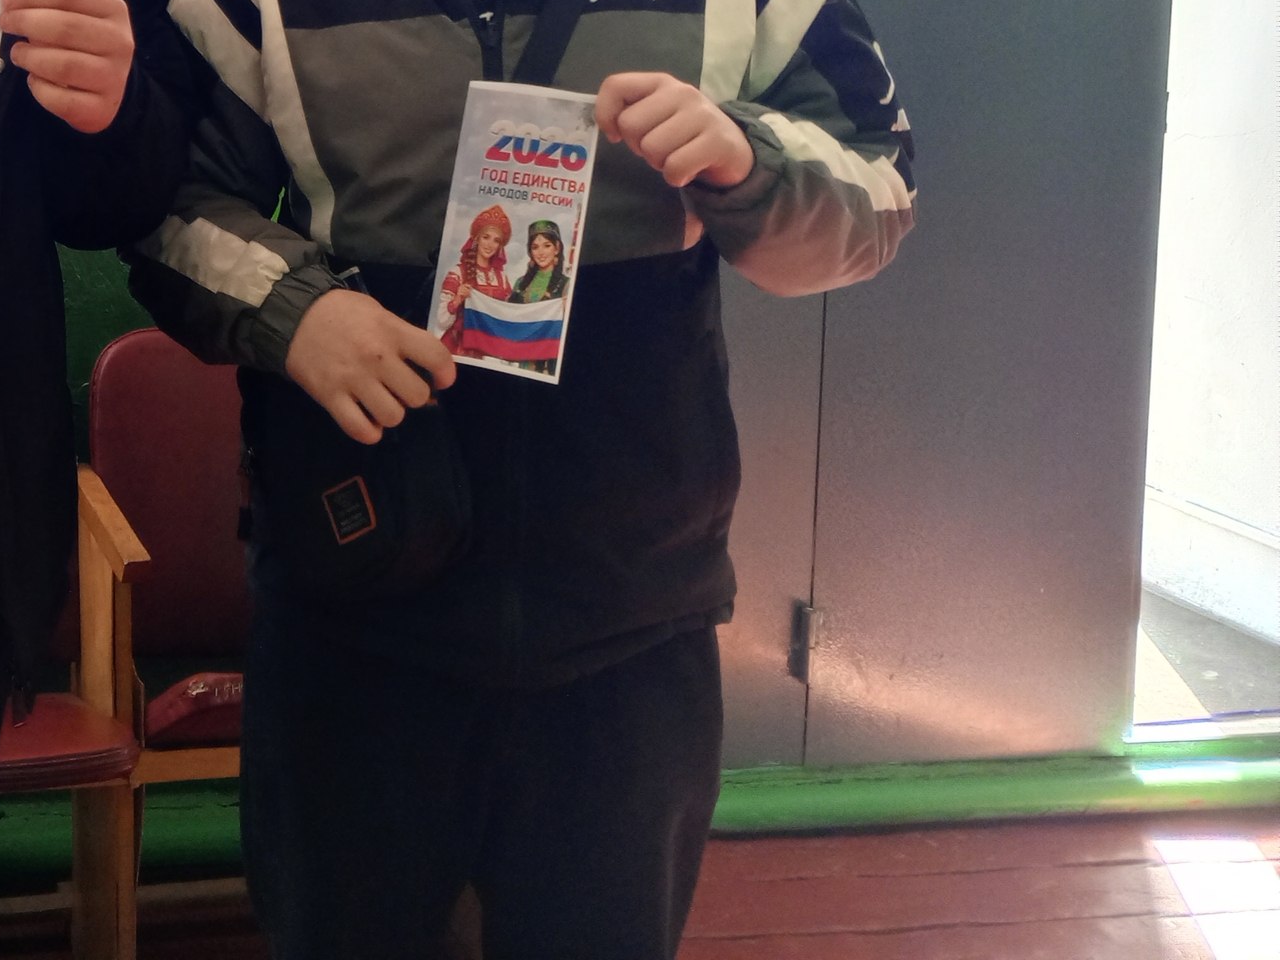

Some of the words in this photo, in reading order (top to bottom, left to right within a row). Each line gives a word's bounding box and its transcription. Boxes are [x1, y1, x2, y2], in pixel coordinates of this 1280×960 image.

[481, 167, 508, 185] ГОД
[512, 172, 586, 194] ЕДИНСТВА
[478, 186, 529, 201] НАРОДОВ
[530, 192, 573, 208] РОССИИ
